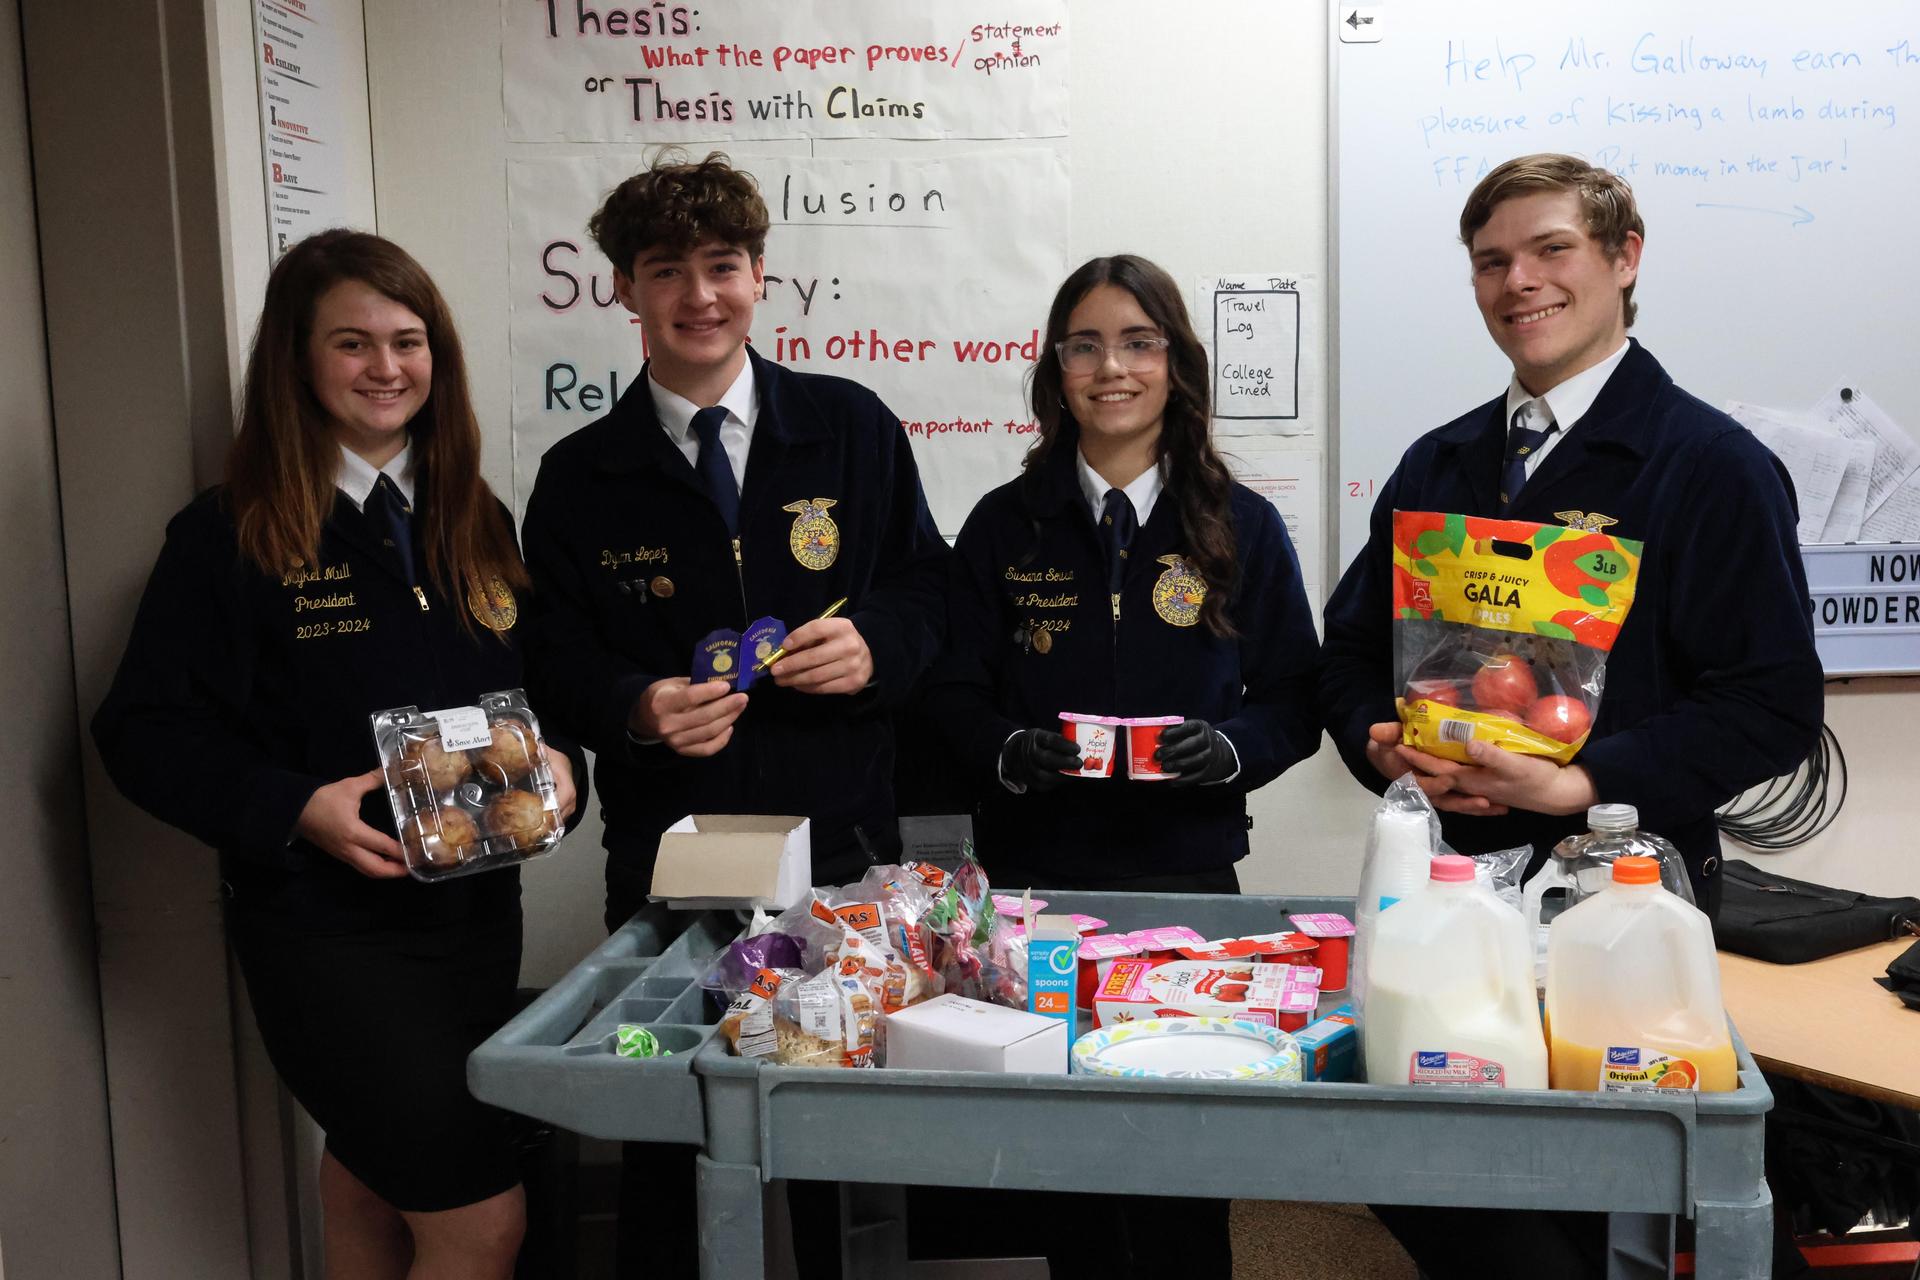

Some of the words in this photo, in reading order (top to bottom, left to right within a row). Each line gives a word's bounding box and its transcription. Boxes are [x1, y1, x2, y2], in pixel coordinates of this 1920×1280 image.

[545, 0, 702, 38] Thesis:
[640, 44, 707, 69] What
[717, 44, 762, 67] the
[774, 45, 854, 78] paper
[974, 51, 1041, 76] opinion
[1446, 40, 1536, 91] Help
[1560, 38, 1609, 71] Mr.
[1632, 33, 1767, 79] Galloway
[1792, 50, 1862, 69] earn
[1887, 40, 1920, 66] th
[585, 75, 614, 95] or
[625, 77, 733, 121] Thesis
[748, 92, 814, 120] with
[826, 86, 925, 120] Claims
[1417, 112, 1527, 148] pleasure
[1549, 97, 1585, 126] of
[1747, 93, 1805, 120] lamb
[1818, 94, 1896, 128] during
[272, 163, 298, 184] BRAVE
[1655, 160, 1709, 182] money
[1719, 159, 1738, 175] in
[1747, 157, 1778, 173] the
[782, 174, 946, 219] lusion
[1216, 278, 1246, 290] Name
[1267, 279, 1297, 290] Date
[1221, 298, 1265, 312] Travel
[1227, 319, 1253, 340] Log
[775, 326, 810, 362] in
[825, 328, 937, 364] other
[953, 328, 1040, 364] word
[1222, 364, 1274, 385] College
[545, 362, 617, 412] Rel
[1230, 381, 1271, 397] Lined
[1348, 479, 1373, 497] 2.1
[635, 546, 668, 565] Lopez
[324, 562, 351, 580] Mull
[1464, 570, 1488, 580] CRISP
[1498, 575, 1530, 587] JUICY
[295, 591, 357, 612] President
[1026, 592, 1079, 607] President
[1464, 583, 1521, 609] GALA
[297, 618, 371, 639] 2023-2024
[705, 640, 738, 652] CALIFORNIA
[1036, 979, 1069, 988] spoons
[1039, 996, 1054, 1008] 24
[1609, 1071, 1648, 1081] Original
